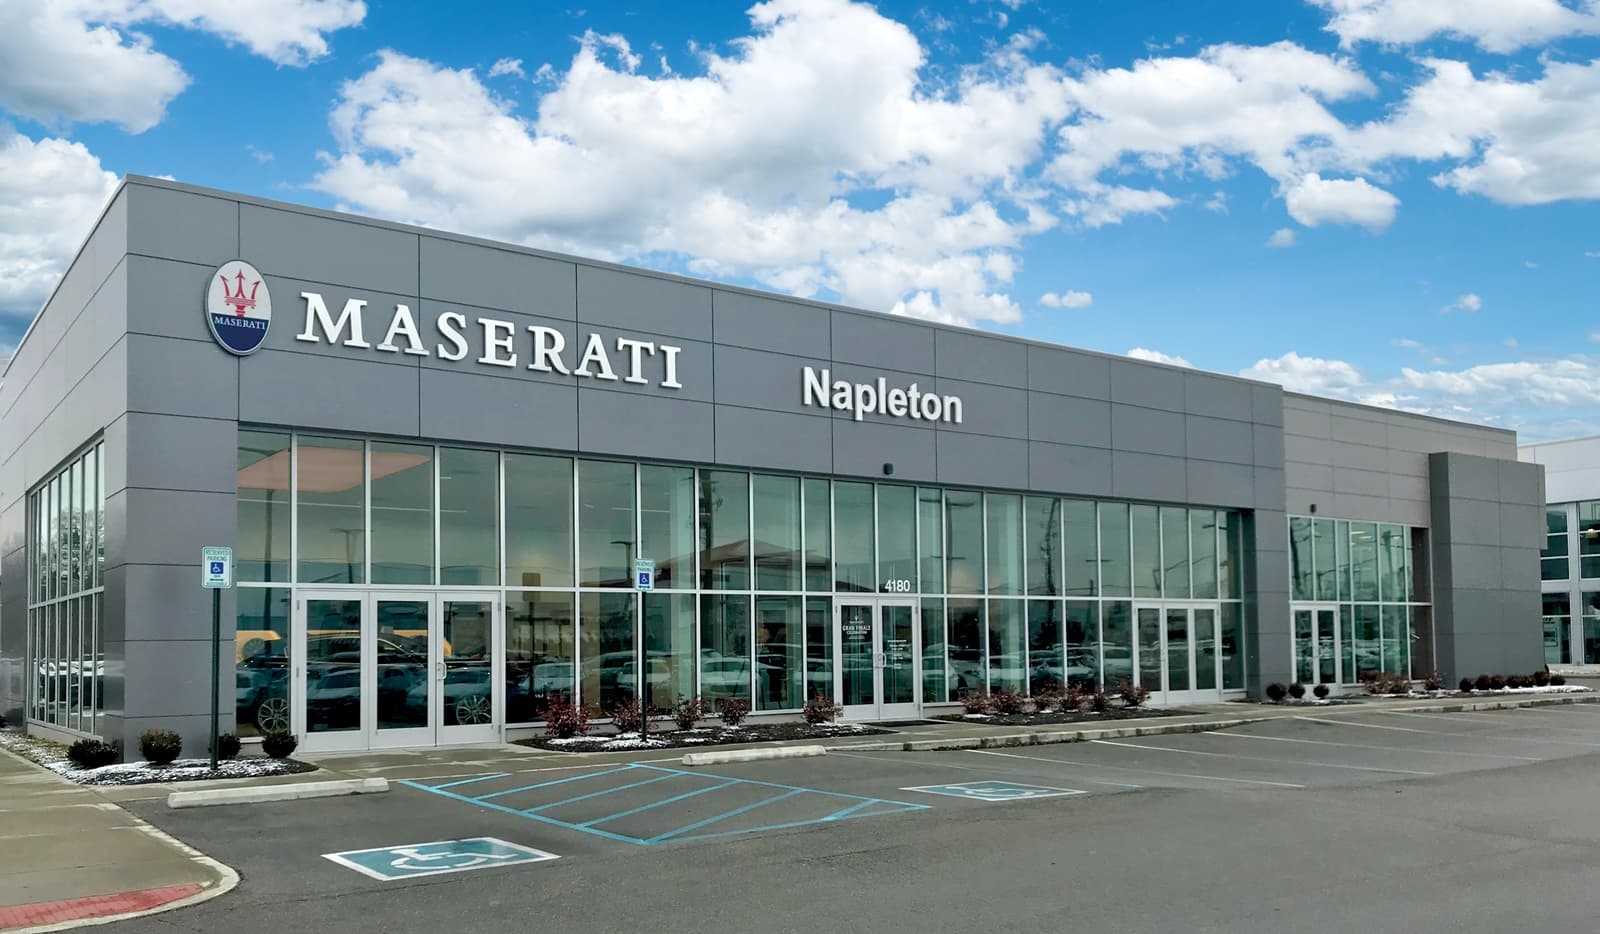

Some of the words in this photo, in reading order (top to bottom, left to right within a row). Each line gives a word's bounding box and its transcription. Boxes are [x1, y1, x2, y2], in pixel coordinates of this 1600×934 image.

[214, 316, 266, 330] MASERATI
[296, 291, 683, 390] MASERATI
[802, 366, 963, 424] Napleton
[884, 579, 911, 592] 4180
